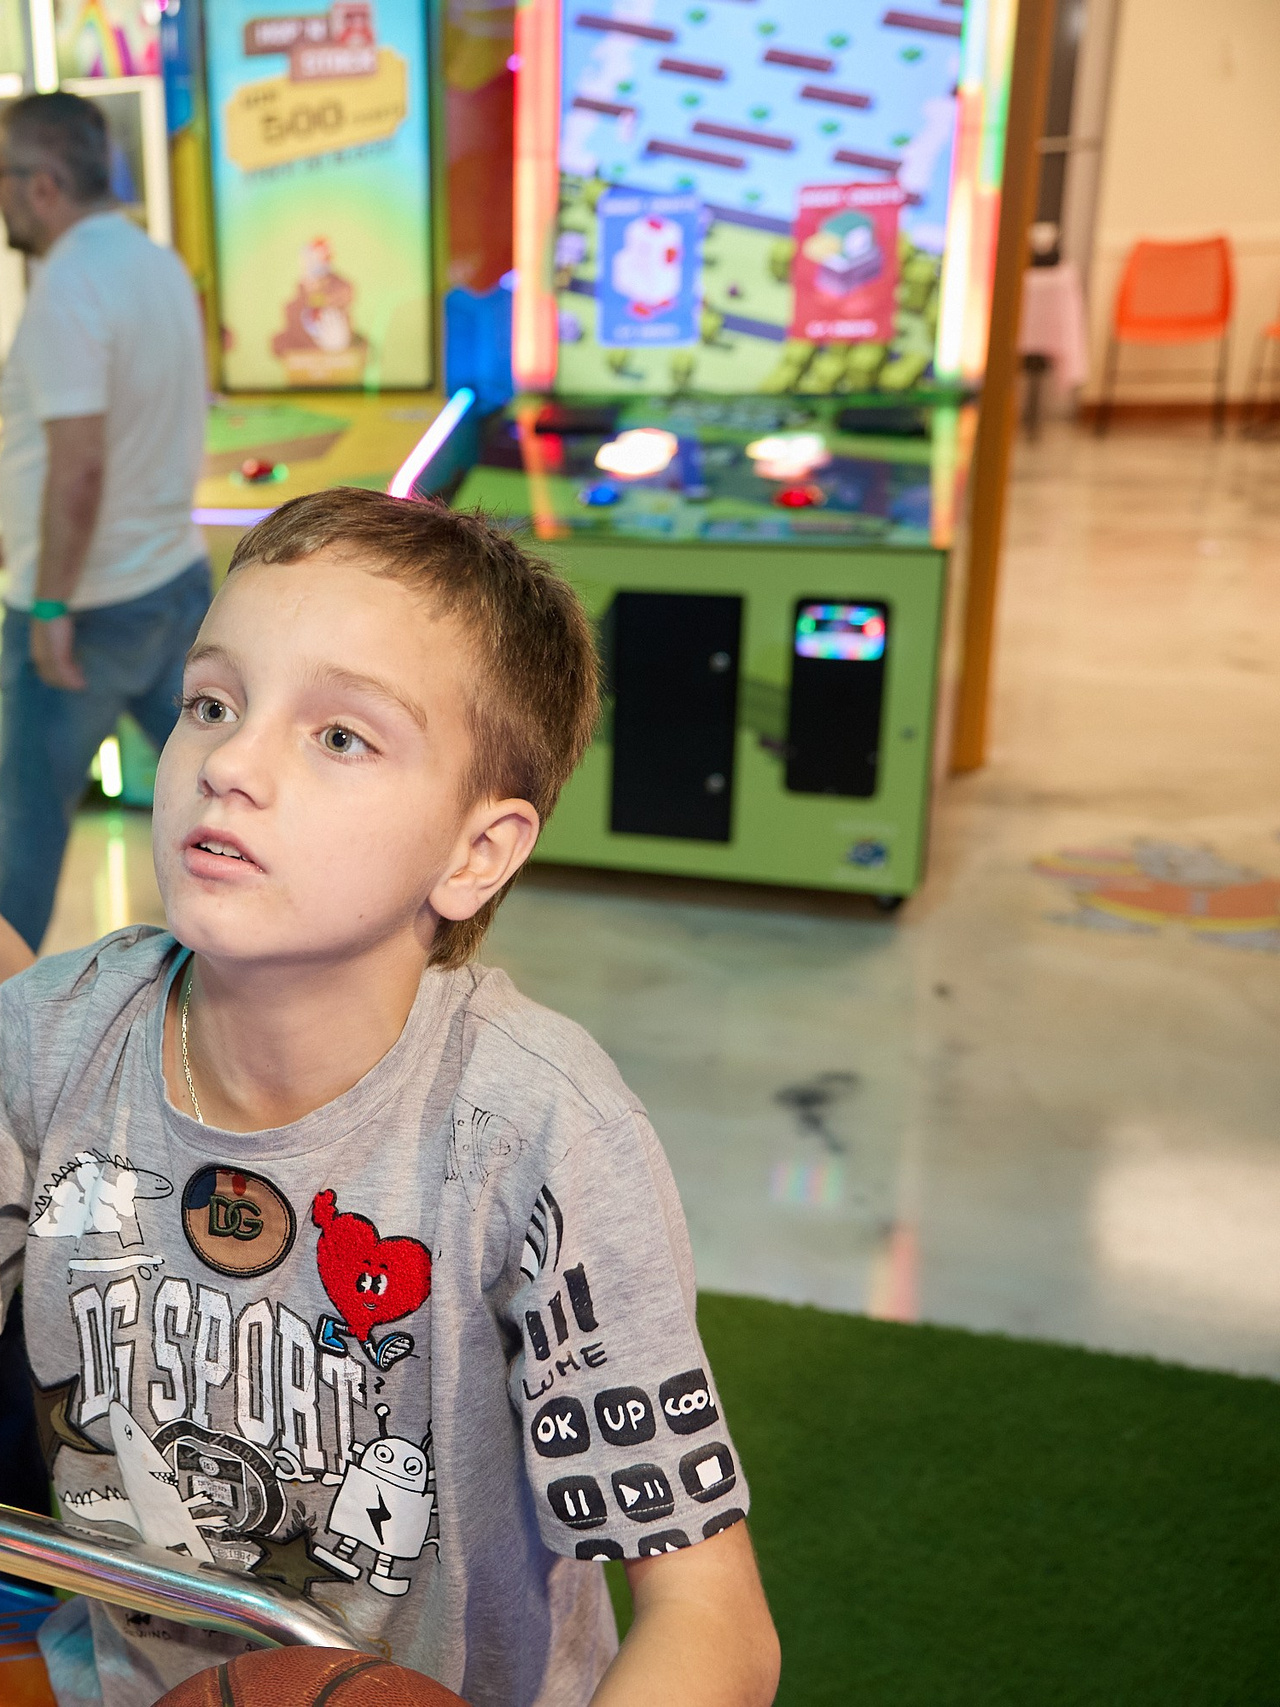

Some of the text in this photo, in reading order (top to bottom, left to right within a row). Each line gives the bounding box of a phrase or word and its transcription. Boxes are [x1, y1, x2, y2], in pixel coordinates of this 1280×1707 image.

[208, 1194, 264, 1241] DG
[69, 1275, 140, 1428] DG
[148, 1275, 368, 1475] SPORT
[537, 1411, 578, 1444] OK
[603, 1399, 646, 1432] UP
